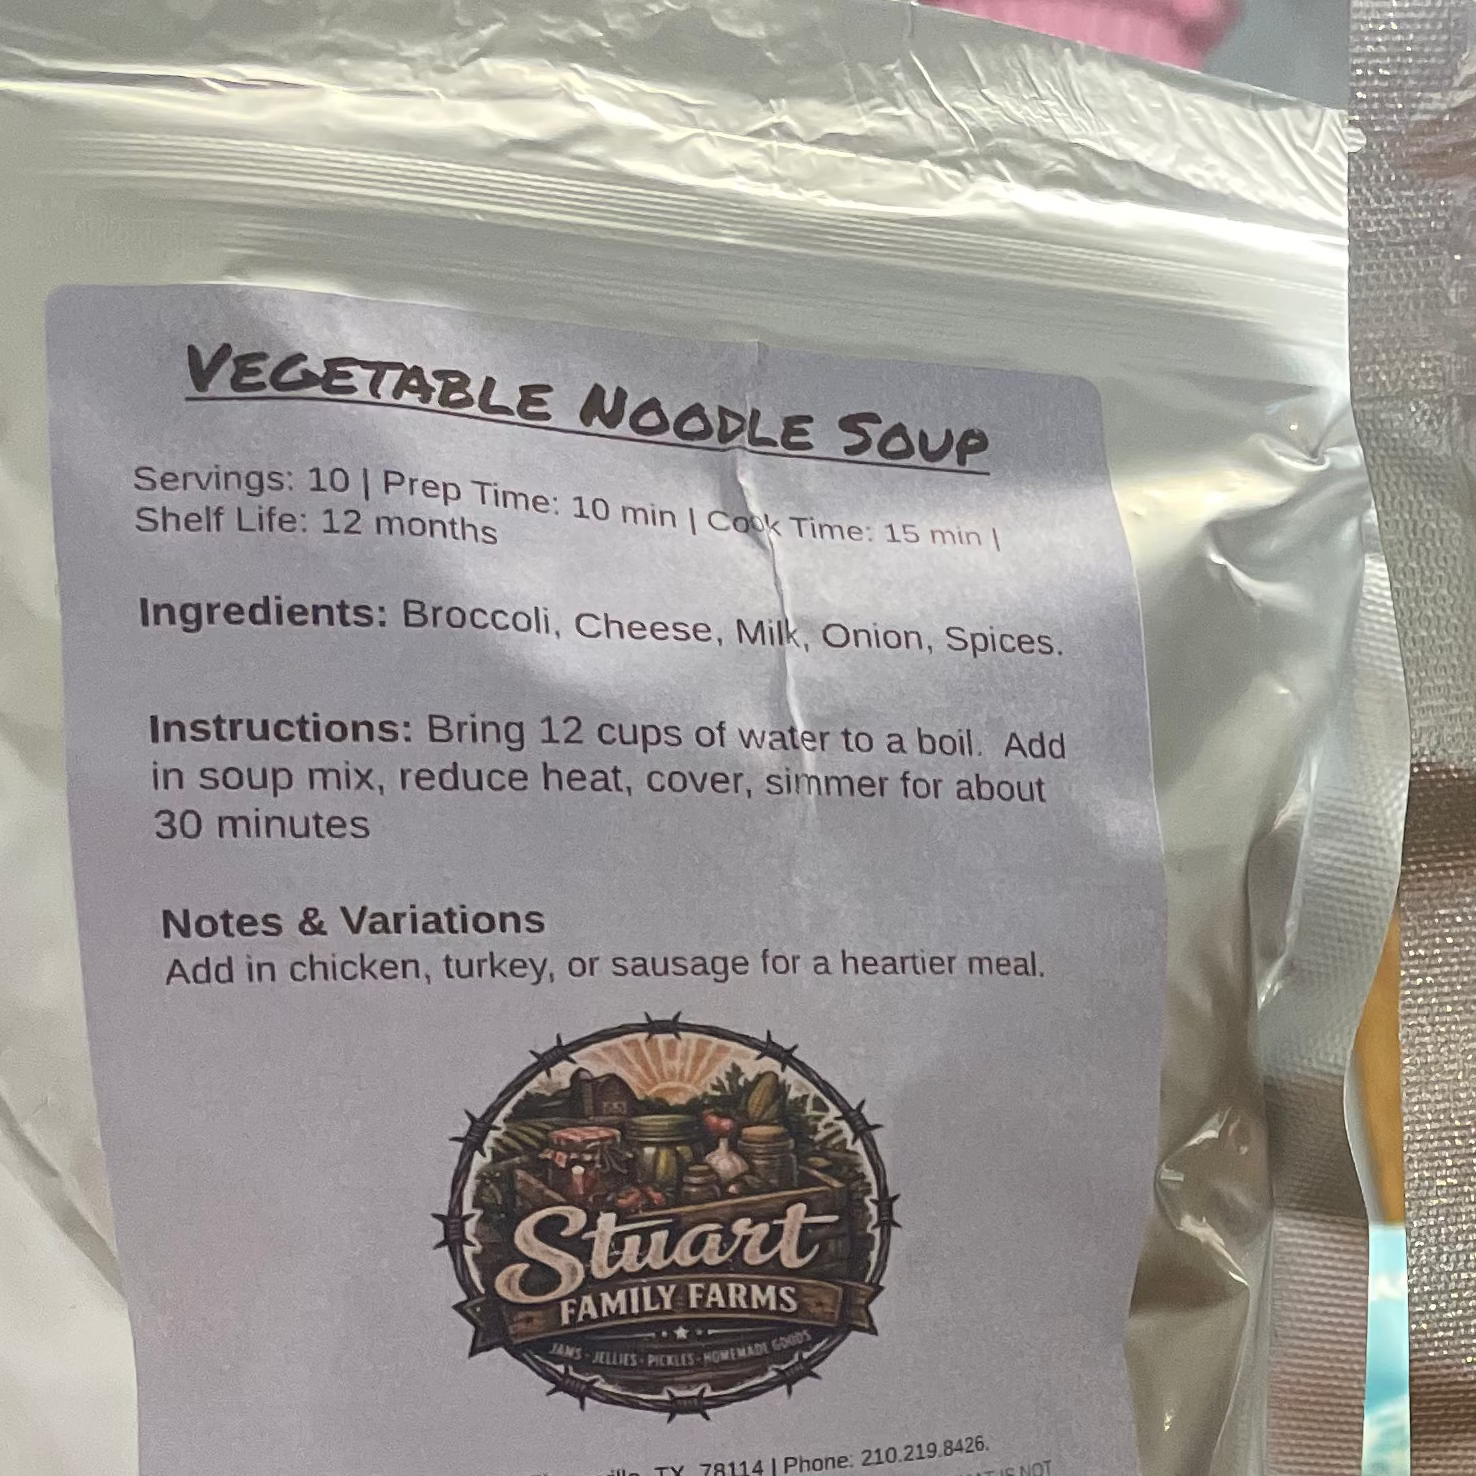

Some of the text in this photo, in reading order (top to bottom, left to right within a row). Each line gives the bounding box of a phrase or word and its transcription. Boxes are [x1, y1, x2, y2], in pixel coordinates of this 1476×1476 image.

[186, 342, 990, 466] VEGETABLE NOODLE SOUP
[134, 464, 293, 497] Servings:
[309, 466, 350, 492] 10
[383, 469, 461, 505] Prep
[471, 480, 559, 515] Time:
[573, 496, 610, 521] 10
[621, 503, 677, 528] min
[708, 510, 782, 537] Cook
[790, 517, 874, 543] Time:
[885, 523, 920, 545] 15
[930, 525, 982, 547] min
[136, 505, 498, 545] Shelf Life: 12 months
[140, 595, 1063, 659] Ingredients: Broccoli, Cheese, Milk, Onion, Spices.
[149, 711, 1065, 759] Instructions: Bring 12 cups of water to a boil. Add
[152, 760, 1046, 803] in soup mix, reduce heat, cover, simmer for about
[154, 807, 370, 840] 30 minutes
[162, 903, 545, 939] Notes & Variations
[165, 948, 1044, 986] Add in chicken, turkey, or sausage for a heartier meal.
[495, 1202, 839, 1303] Stuart
[560, 1283, 799, 1326] FAMILY FARMS
[783, 1453, 854, 1476] Phone:
